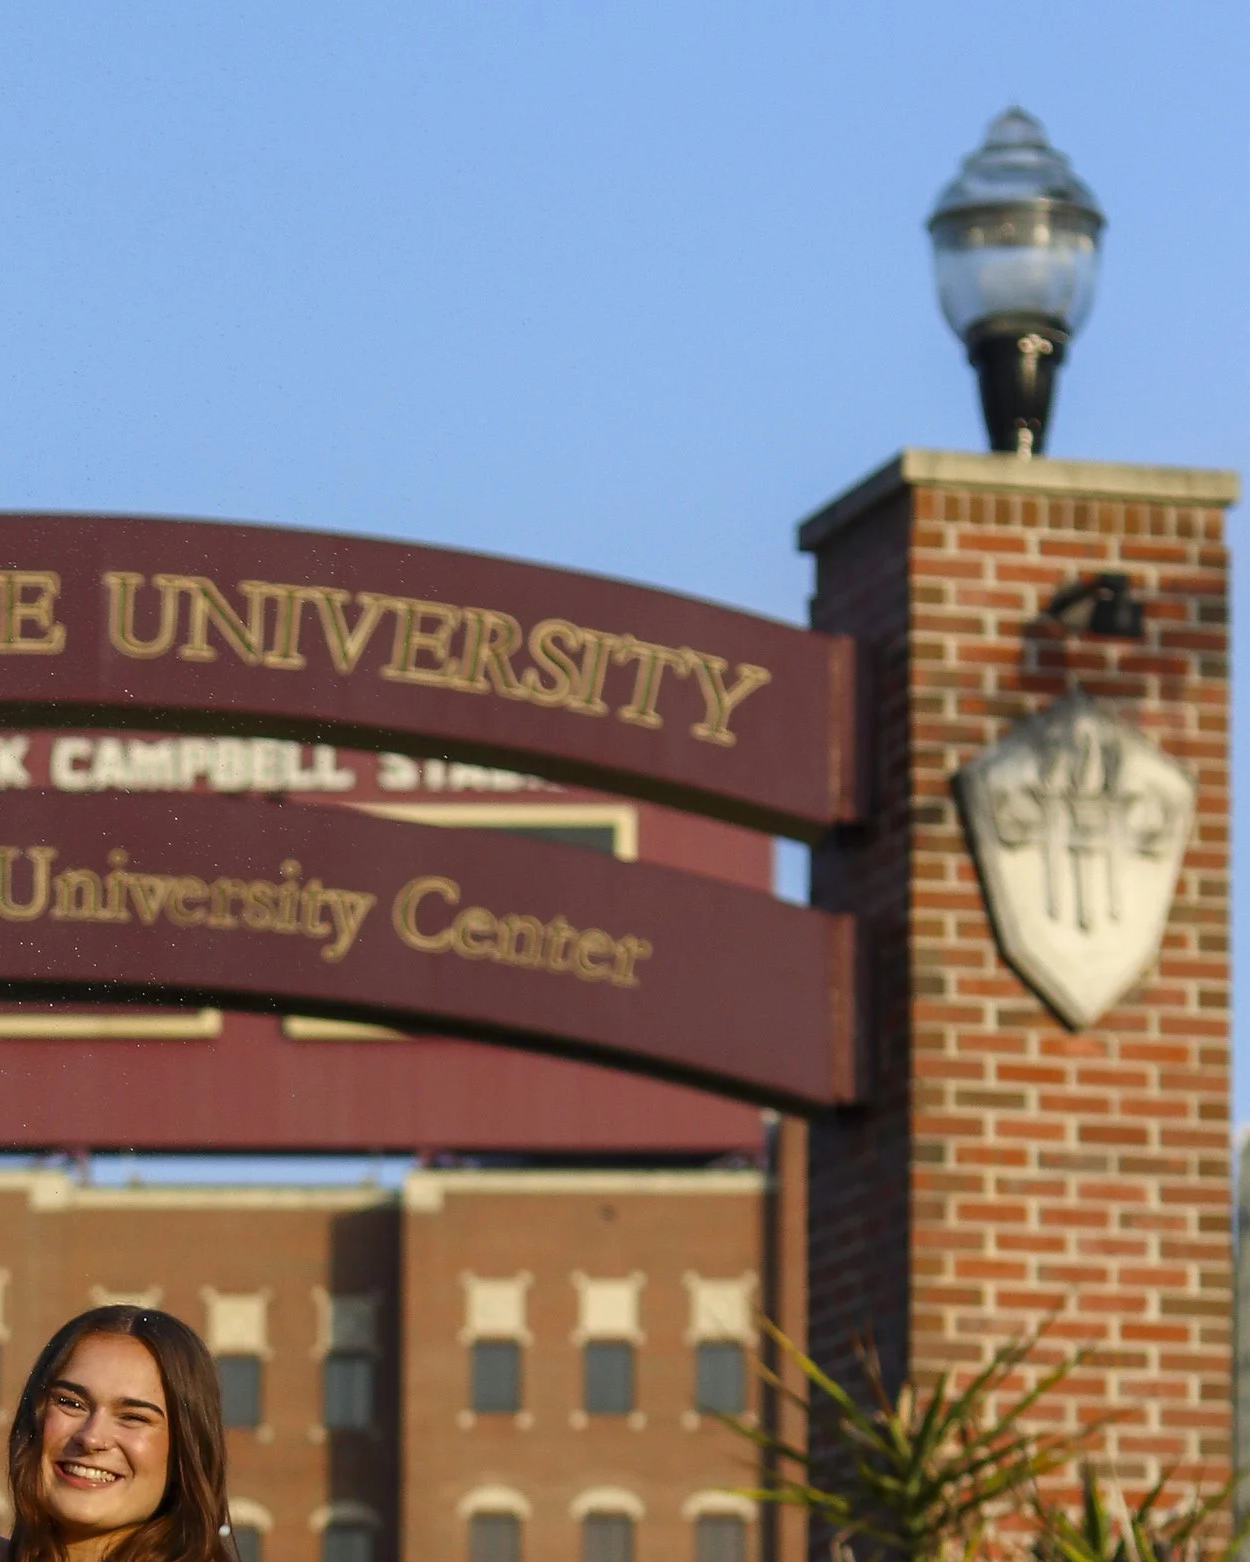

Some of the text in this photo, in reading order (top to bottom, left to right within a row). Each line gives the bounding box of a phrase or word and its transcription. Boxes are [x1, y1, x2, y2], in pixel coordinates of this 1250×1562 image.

[105, 572, 770, 745] UNIVERSITY
[51, 735, 356, 793] CAMPBELL
[392, 875, 652, 986] Center
